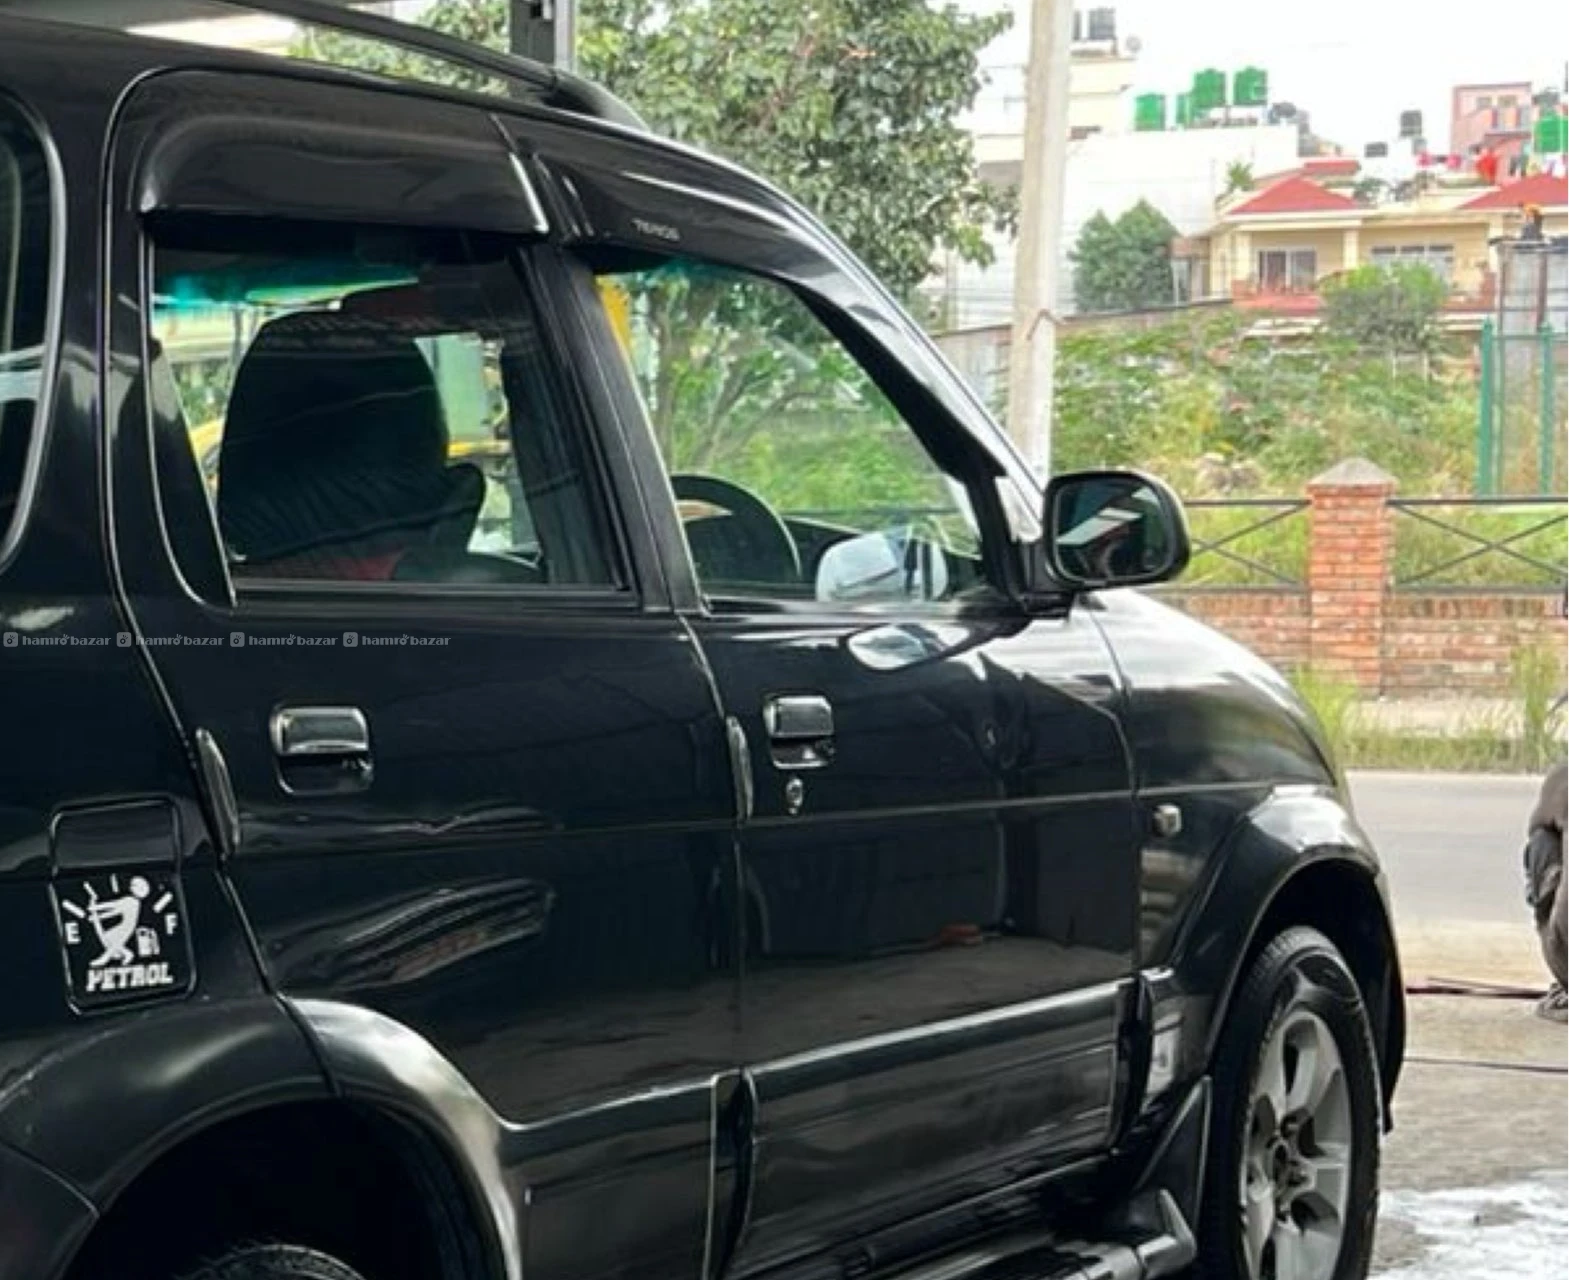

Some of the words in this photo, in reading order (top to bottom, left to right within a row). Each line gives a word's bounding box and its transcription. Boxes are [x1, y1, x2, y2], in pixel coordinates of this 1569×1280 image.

[65, 922, 81, 945] E
[165, 912, 178, 935] F
[86, 962, 174, 992] PETROL
